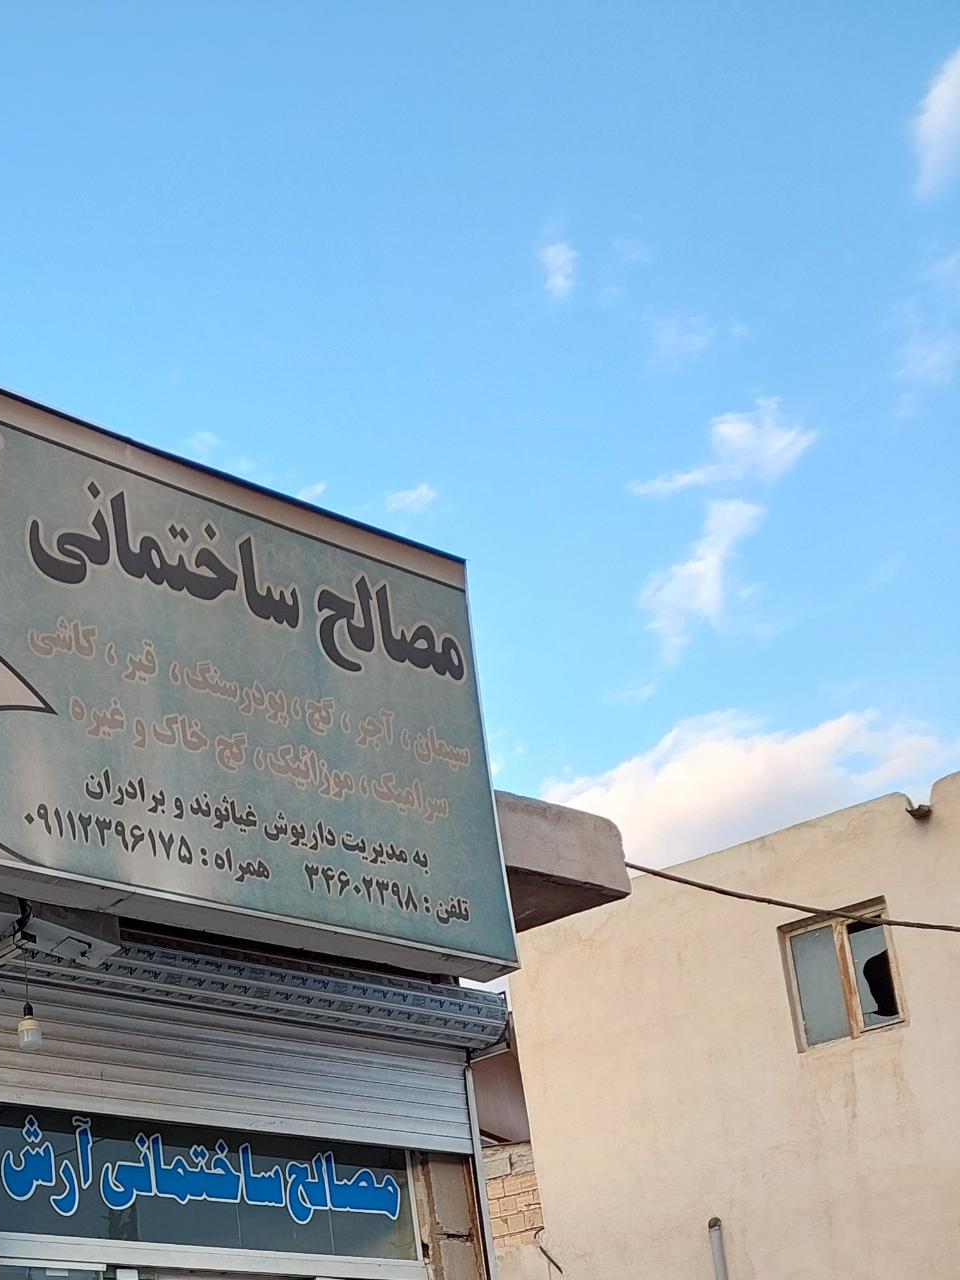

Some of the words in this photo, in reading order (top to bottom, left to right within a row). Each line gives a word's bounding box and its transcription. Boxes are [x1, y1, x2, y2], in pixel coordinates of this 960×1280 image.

[28, 481, 299, 632] ساختمانی
[26, 616, 98, 659] کاشی
[316, 572, 467, 684] مصالح
[69, 696, 126, 738] غیره
[134, 716, 147, 749] و
[152, 712, 208, 754] خاک
[215, 733, 248, 773] گچ
[84, 768, 167, 816] برادران
[173, 795, 186, 820] و
[23, 801, 194, 866] ۰۹۱۱۲۳۹۶۱۷۵
[189, 793, 259, 834] غیاثوند
[263, 810, 336, 851] داریوش
[341, 830, 409, 866] مدیریت
[412, 848, 431, 876] به
[303, 862, 420, 914] ۳۴۶۰۲۳۹۸
[0, 1114, 93, 1217] آرش
[100, 1132, 286, 1213] ساختمانی
[285, 1151, 402, 1225] مصالح
